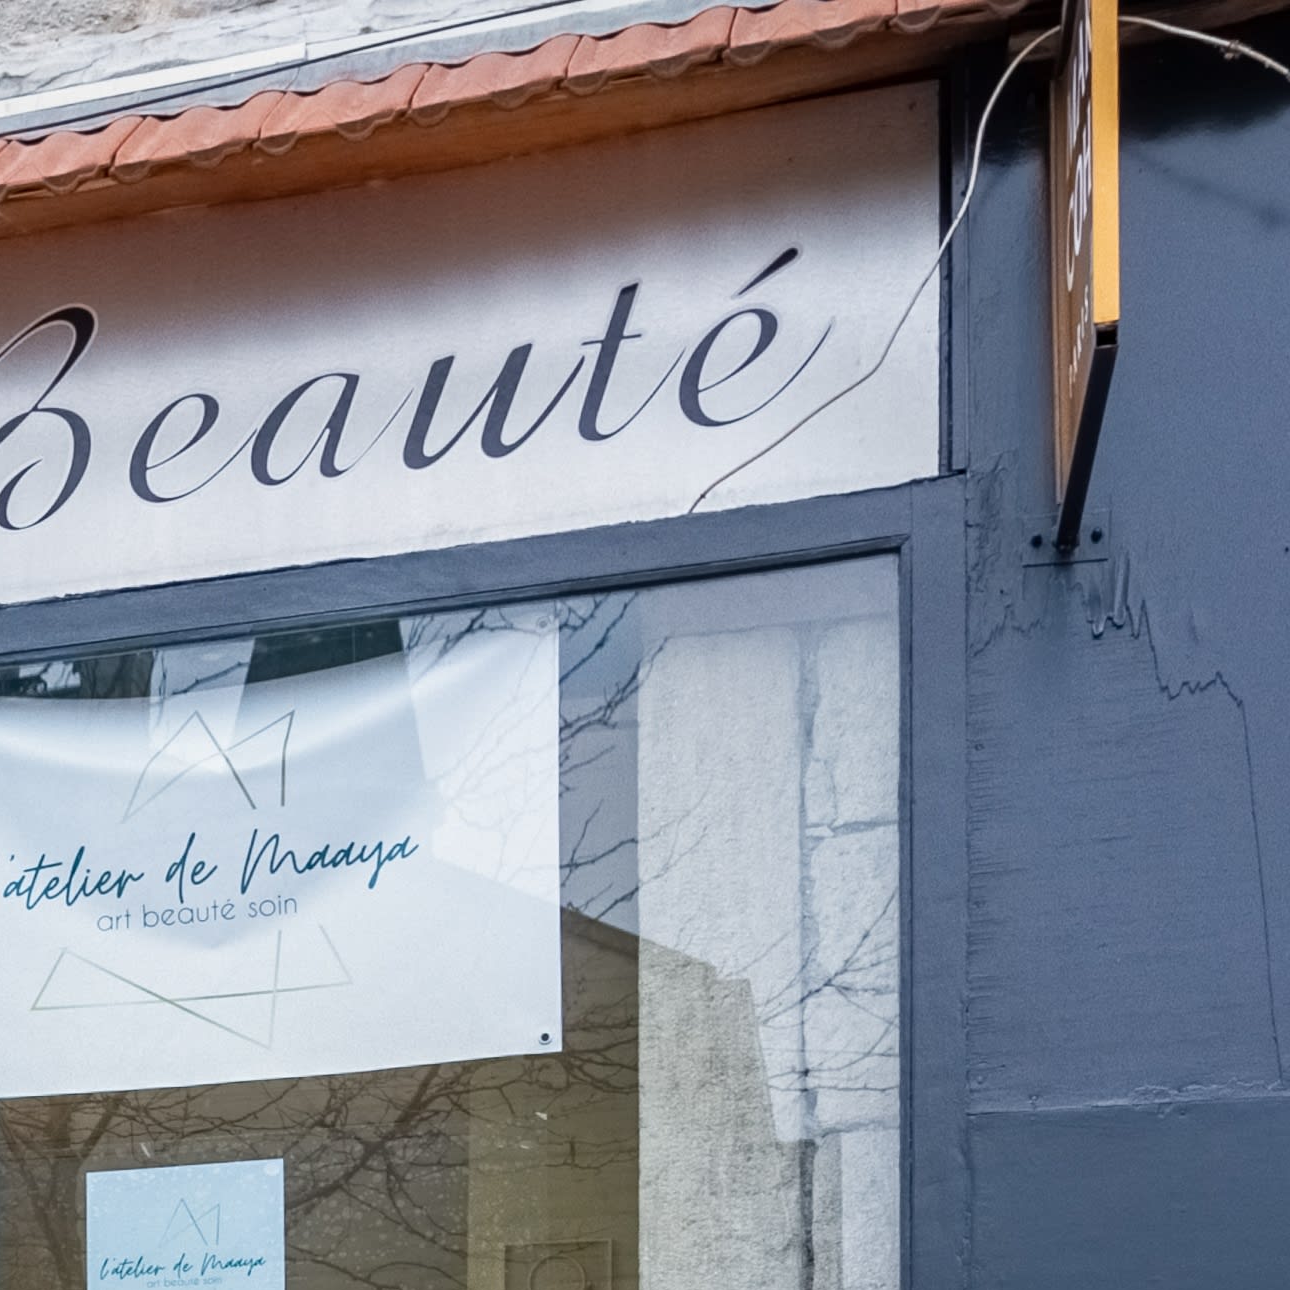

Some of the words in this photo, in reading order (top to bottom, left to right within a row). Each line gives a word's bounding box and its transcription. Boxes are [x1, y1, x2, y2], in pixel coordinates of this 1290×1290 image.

[1069, 284, 1089, 398] PARIS
[166, 832, 217, 904] de
[241, 828, 419, 894] Maaya
[96, 909, 132, 932] art
[142, 897, 236, 929] beauté
[248, 895, 298, 919] soin
[172, 1253, 192, 1274] de
[201, 1252, 267, 1276] Maaya
